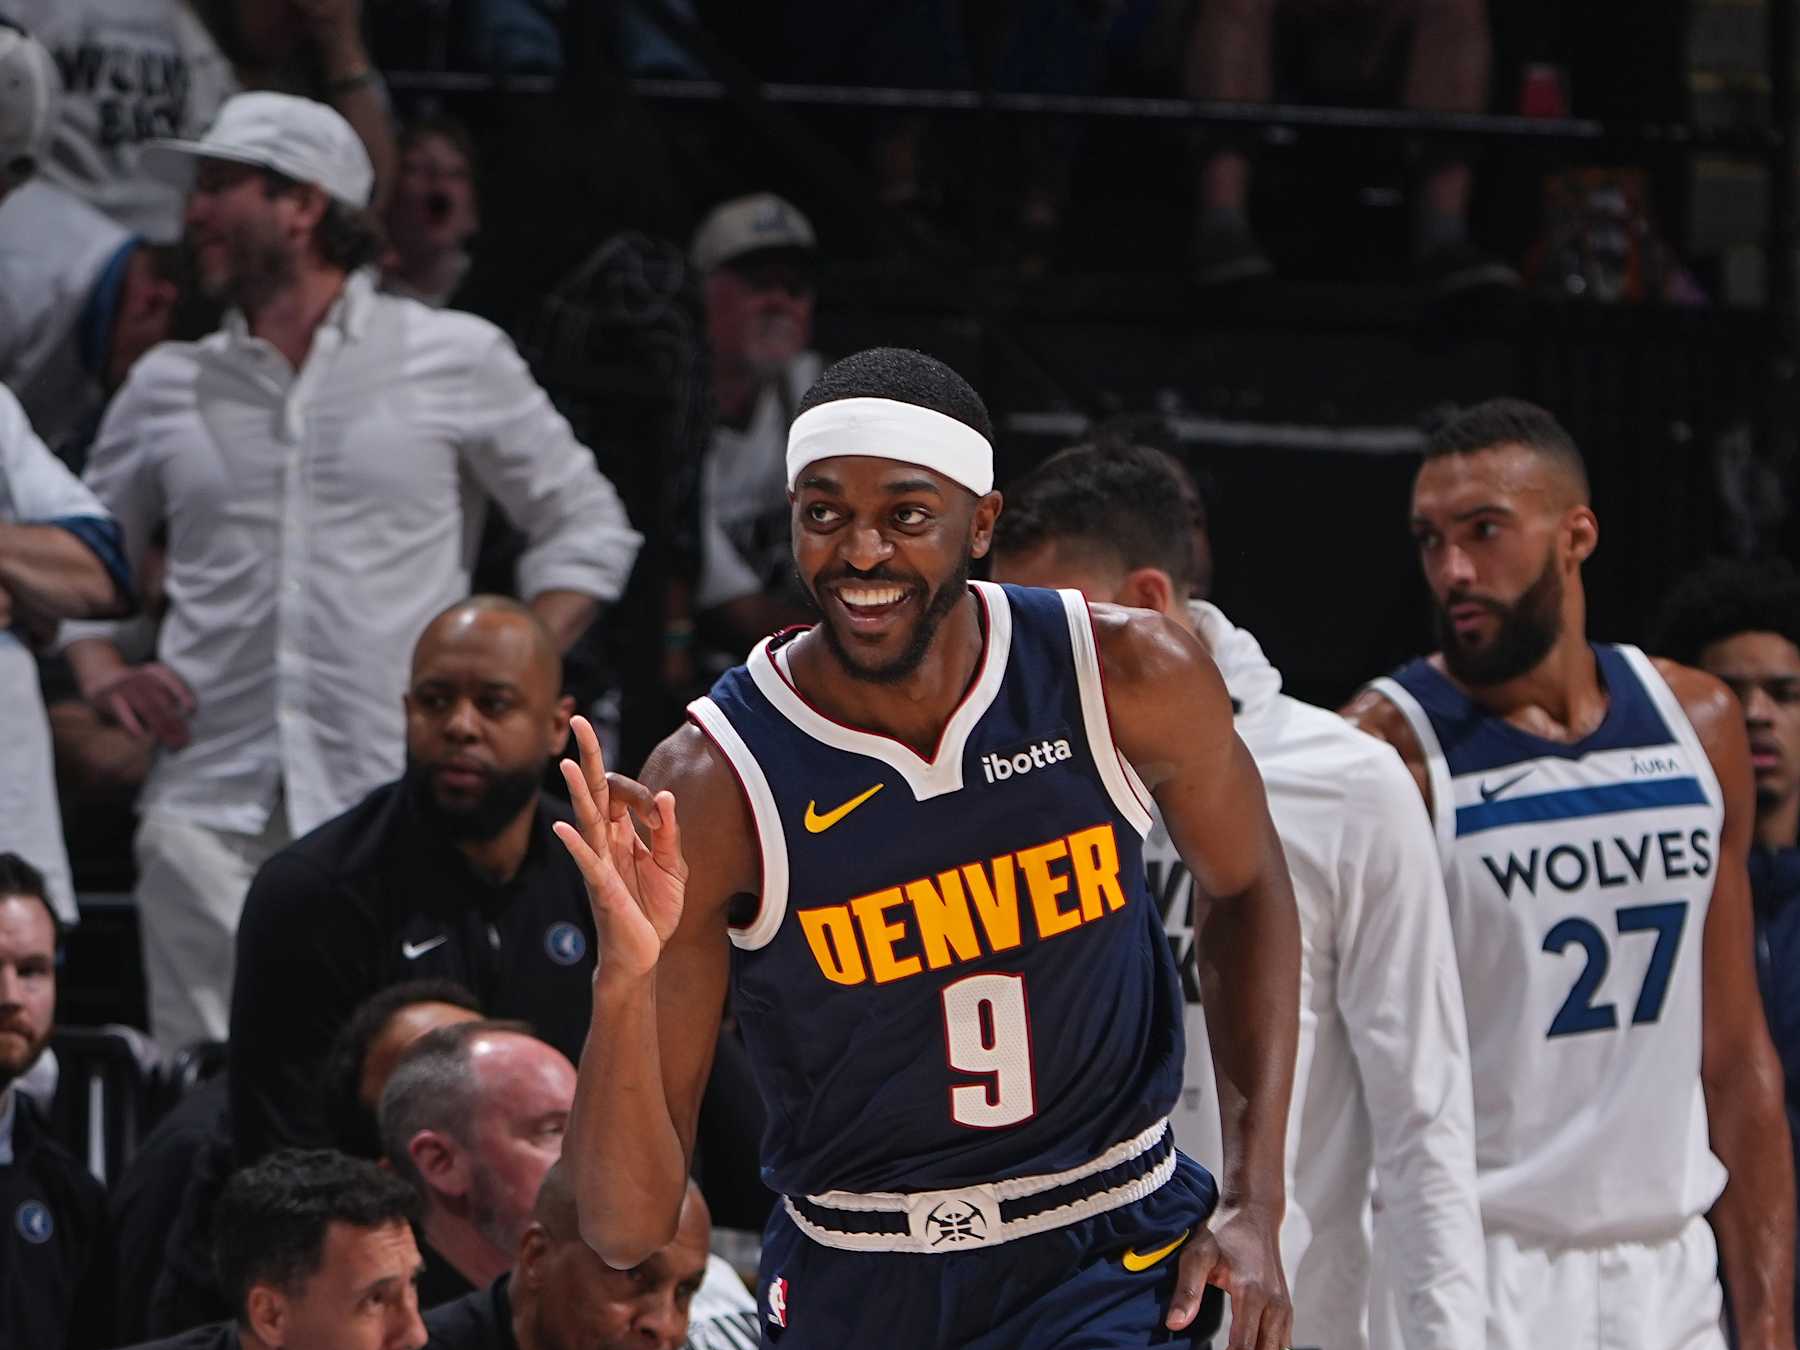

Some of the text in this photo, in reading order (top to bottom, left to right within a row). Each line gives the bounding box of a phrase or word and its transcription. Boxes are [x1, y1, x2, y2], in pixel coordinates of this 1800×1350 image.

[982, 739, 1072, 783] ibotta
[797, 822, 1126, 986] DENVER
[1483, 828, 1712, 898] WOLVES
[1541, 901, 1690, 1040] 27
[941, 971, 1037, 1129] 9
